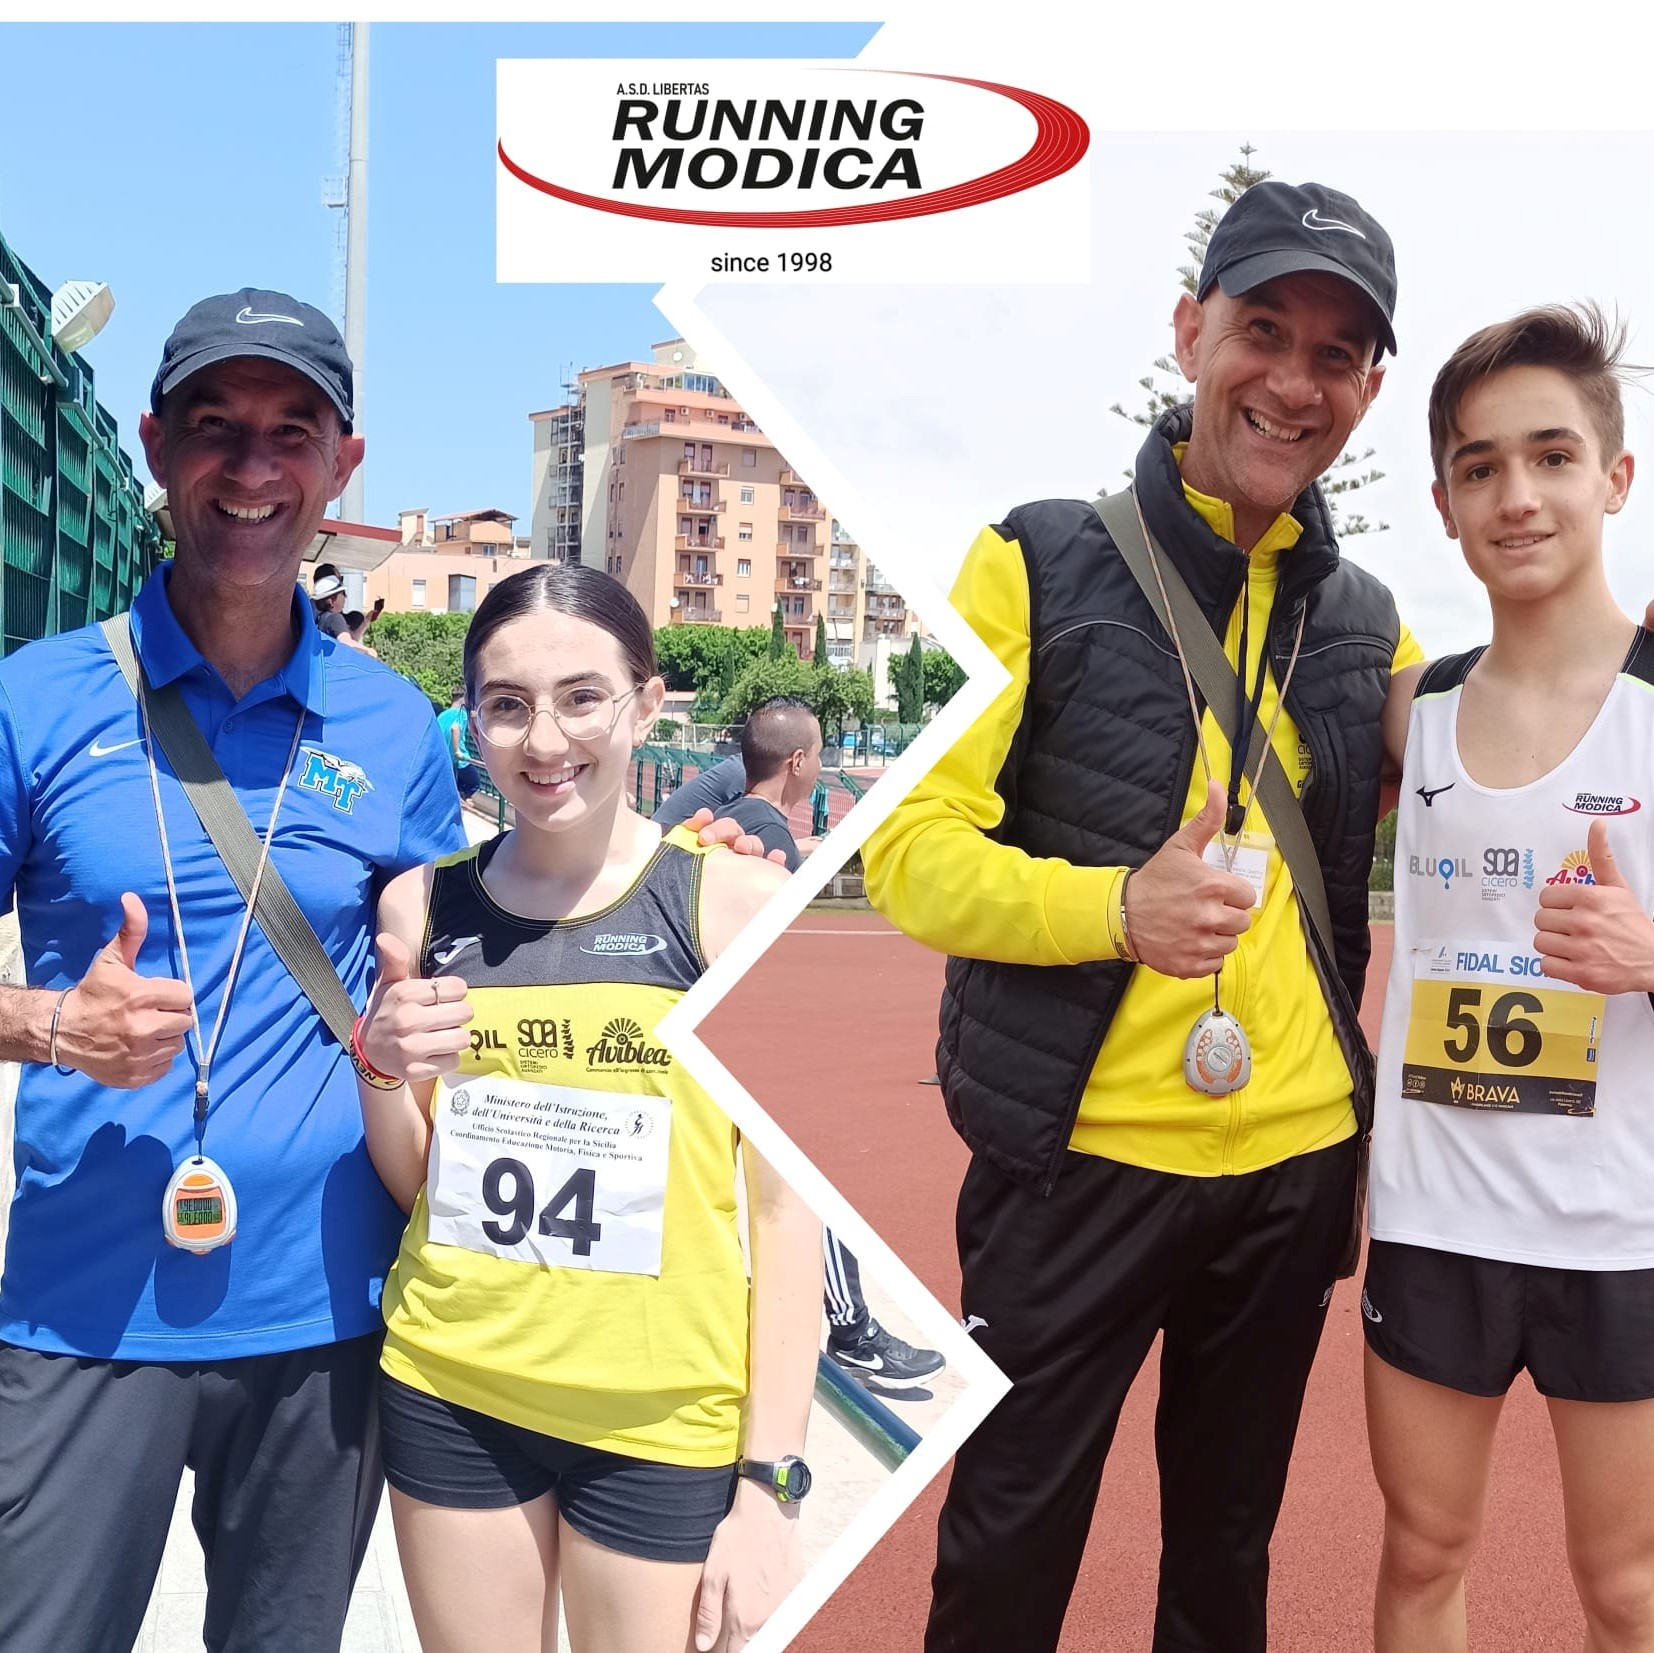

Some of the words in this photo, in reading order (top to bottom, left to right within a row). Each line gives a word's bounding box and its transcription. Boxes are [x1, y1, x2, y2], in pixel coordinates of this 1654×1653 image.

[1574, 802, 1621, 812] MODICA
[1575, 795, 1624, 805] RUNNING
[1481, 877, 1518, 888] cicero
[593, 934, 648, 945] RUNNING
[593, 942, 647, 952] MODICA
[1456, 952, 1505, 974] FIDAL
[1509, 955, 1549, 977] SIC
[1443, 987, 1544, 1068] 56
[518, 1047, 559, 1059] cicero
[586, 1036, 671, 1067] Aviblea
[1466, 1083, 1521, 1104] BRAVA
[484, 1094, 531, 1109] Ministero
[533, 1101, 608, 1121] dell'Istruzione,
[472, 1122, 495, 1133] Ufficio
[496, 1126, 532, 1138] Scolastico
[533, 1131, 568, 1143] Regionale
[569, 1137, 581, 1146] per
[583, 1138, 591, 1147] la
[592, 1139, 617, 1149] Sicilia
[545, 1119, 551, 1127] e
[553, 1118, 577, 1130] della
[579, 1121, 621, 1135] Ricerca
[450, 1128, 500, 1144] Coordinamento
[501, 1136, 544, 1150] Educazione
[545, 1143, 576, 1156] Motoria,
[578, 1147, 601, 1158] Fisica
[608, 1151, 643, 1162] Sportiva
[481, 1157, 602, 1257] 94
